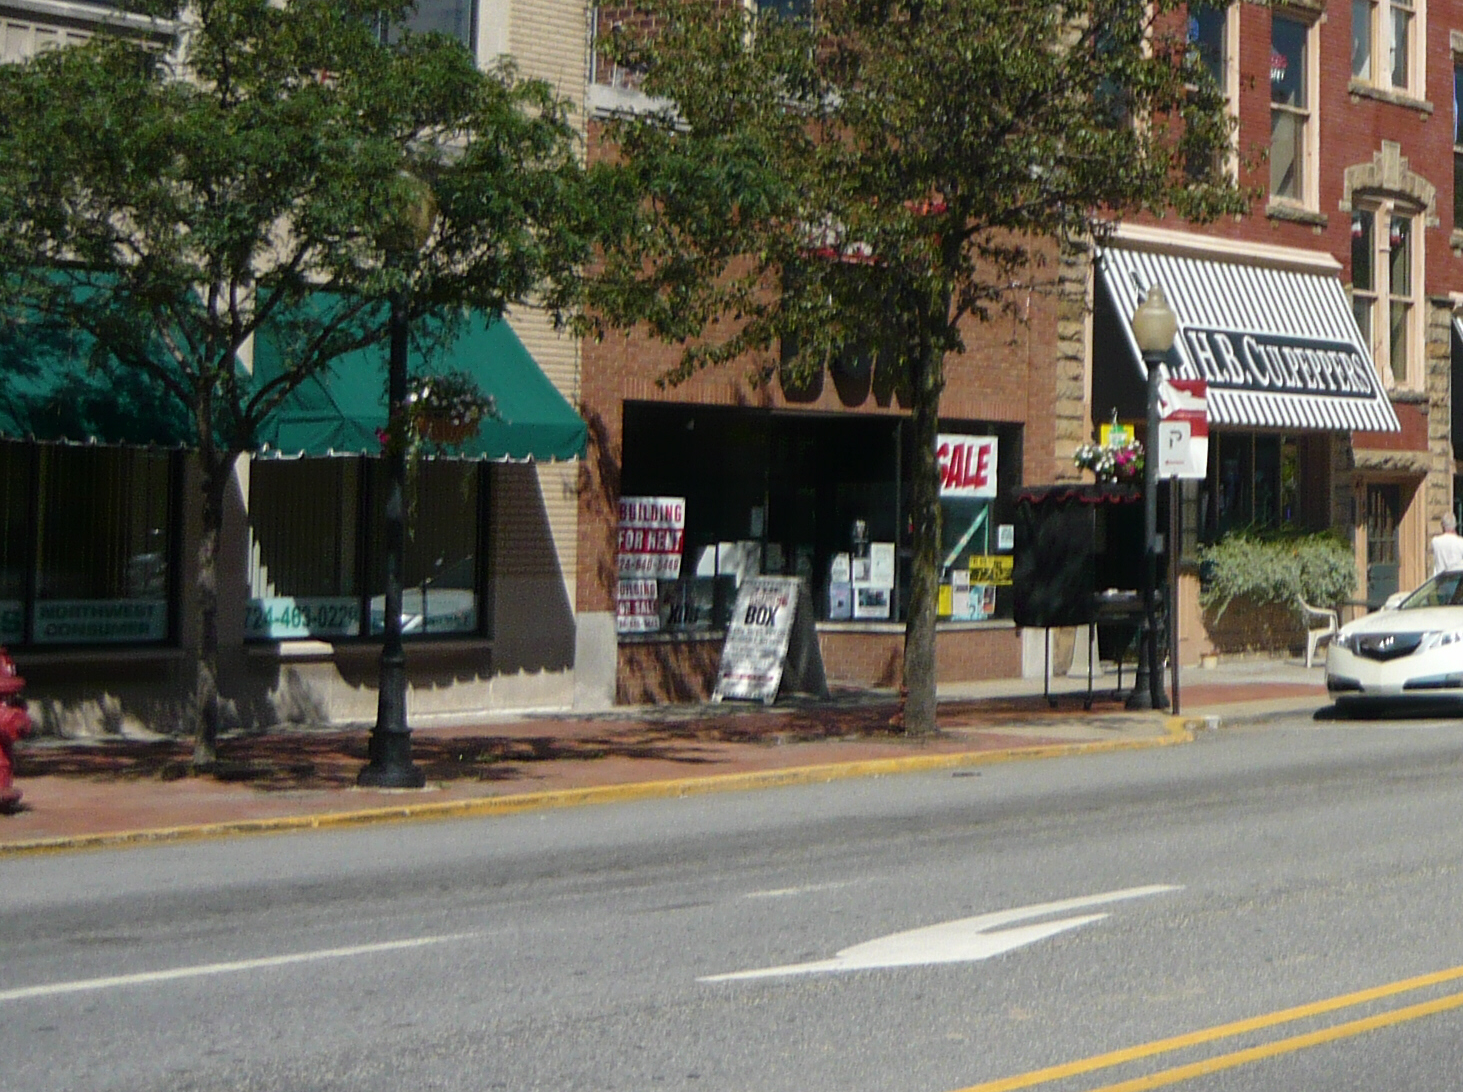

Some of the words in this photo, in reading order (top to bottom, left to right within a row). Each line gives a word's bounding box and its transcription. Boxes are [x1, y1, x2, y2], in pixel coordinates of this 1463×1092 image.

[937, 442, 991, 489] SALE
[620, 504, 682, 522] BUILDING
[618, 529, 644, 553] FOR
[619, 582, 656, 596] UILDING
[744, 604, 780, 627] BOX
